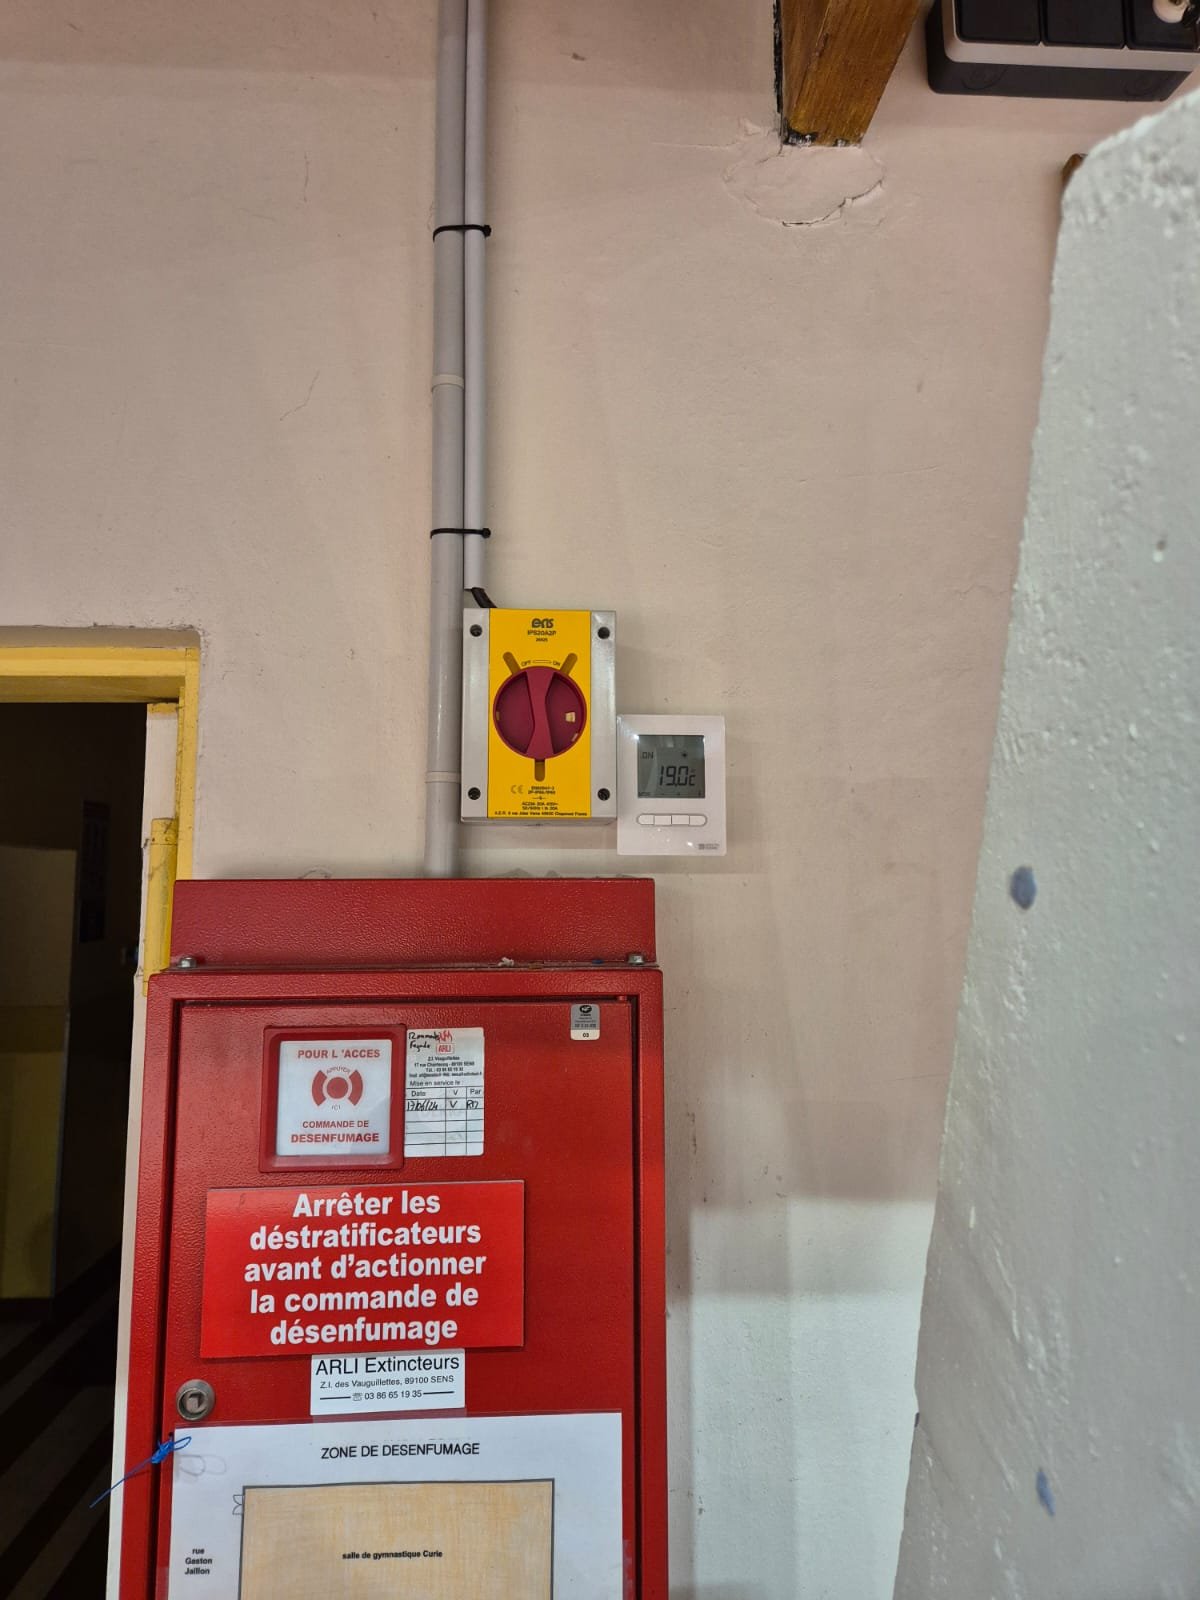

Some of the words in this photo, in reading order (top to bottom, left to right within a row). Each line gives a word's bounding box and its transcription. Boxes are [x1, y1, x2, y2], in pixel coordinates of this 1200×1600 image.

[297, 1049, 329, 1059] POUR
[326, 1065, 352, 1075] APPUYER
[302, 1120, 355, 1129] COMMANDE
[357, 1120, 369, 1128] DE
[291, 1133, 380, 1143] DESENFUMAGE
[292, 1192, 393, 1218] Arrêter
[401, 1190, 441, 1214] les
[250, 1221, 481, 1250] déstratificateurs
[244, 1255, 322, 1282] avant
[250, 1289, 275, 1313] la
[284, 1283, 437, 1312] commande
[446, 1281, 479, 1306] de
[270, 1316, 458, 1345] désenfumage
[315, 1357, 358, 1375] ARLI
[365, 1355, 460, 1373] Extincteurs
[320, 1381, 332, 1389] Z.I.
[335, 1380, 349, 1388] des
[352, 1378, 403, 1389] Vauguillettes,
[404, 1377, 428, 1385] 89100
[430, 1375, 454, 1383] SENS
[364, 1392, 375, 1400] 03
[388, 1391, 399, 1399] 65
[412, 1390, 422, 1398] 35
[321, 1446, 357, 1459] ZONE
[361, 1445, 379, 1457] DE
[382, 1443, 480, 1456] DESENFUMAGE
[185, 1557, 213, 1565] Gaston
[373, 1550, 421, 1560] gymnastique
[422, 1549, 443, 1558] Curie
